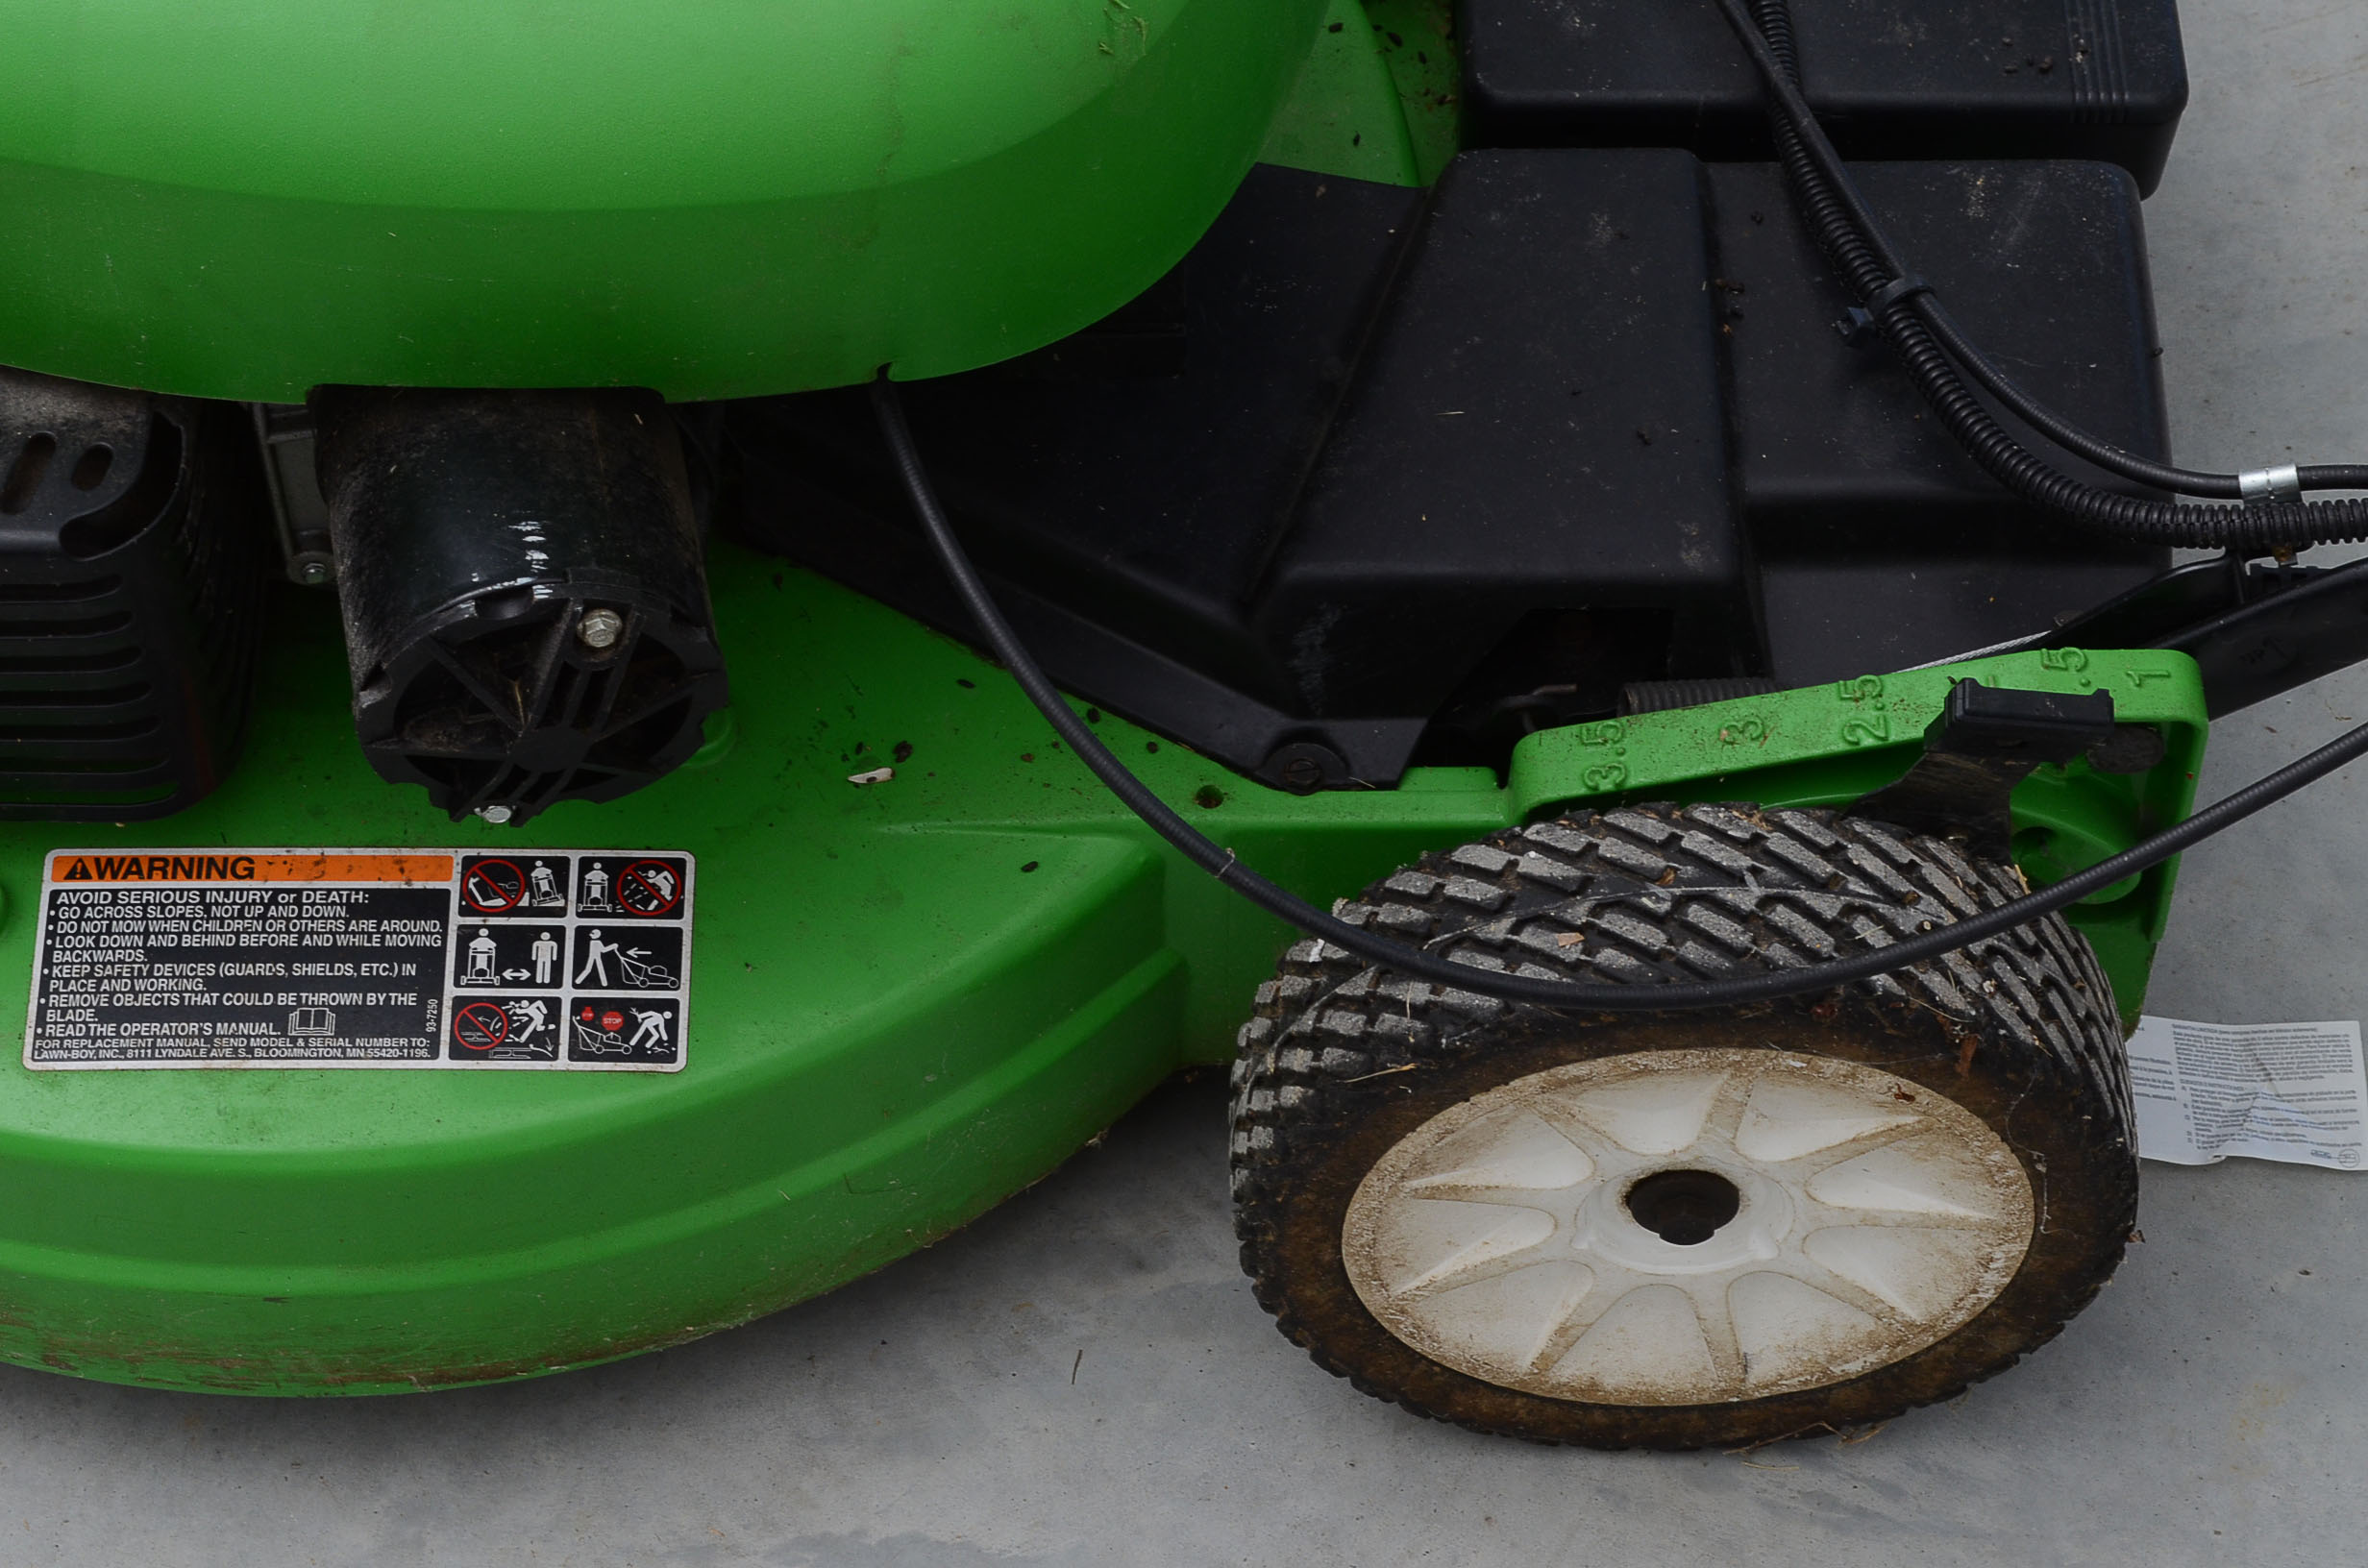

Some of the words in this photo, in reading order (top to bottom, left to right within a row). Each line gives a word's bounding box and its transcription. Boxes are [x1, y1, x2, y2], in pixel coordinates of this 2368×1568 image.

[2041, 646, 2088, 689] .5
[2125, 669, 2171, 687] 1
[93, 857, 256, 881] WARNING
[57, 892, 112, 904] AVOID
[117, 892, 201, 903] SERIOUS
[205, 891, 273, 903] INJURY
[278, 894, 297, 903] or
[302, 891, 369, 903] DEATH:
[58, 907, 81, 919] GO
[84, 906, 143, 918] ACROSS
[146, 906, 207, 919] SLOPES,
[210, 905, 240, 917] NOT
[267, 906, 299, 917] AND
[302, 906, 350, 917] DOWN.
[57, 921, 78, 933] DO
[80, 920, 110, 933] NOT
[111, 920, 146, 932] MOW
[148, 920, 189, 932] WHEN
[192, 919, 262, 931] CHILDREN
[265, 919, 286, 932] OR
[288, 919, 346, 931] OTHERS
[348, 920, 378, 931] ARE
[379, 920, 443, 932] AROUND.
[56, 936, 95, 947] LOOK
[98, 935, 143, 947] DOWN
[146, 935, 178, 946] AND
[181, 935, 235, 946] BEHIND
[239, 934, 299, 946] BEFORE
[302, 935, 333, 946] AND
[336, 935, 381, 946] WHILE
[385, 935, 442, 946] MOVING
[53, 949, 148, 962] BACKWARDS.
[52, 965, 90, 977] KEEP
[93, 965, 150, 976] SAFETY
[152, 964, 216, 976] DEVICES
[219, 964, 288, 979] (GUARDS,
[291, 964, 358, 977] SHIELDS,
[362, 963, 399, 977] ETC.)
[401, 964, 416, 975] IN
[49, 979, 97, 992] PLACE
[100, 979, 132, 992] AND
[134, 979, 207, 991] WORKING.
[48, 994, 111, 1007] REMOVE
[112, 993, 180, 1006] OBJECTS
[183, 993, 221, 1005] THAT
[223, 993, 274, 1005] COULD
[277, 993, 298, 1005] BE
[299, 992, 364, 1005] THROWN
[366, 993, 385, 1005] BY
[389, 993, 417, 1005] THE
[46, 1009, 98, 1021] BLADE.
[426, 998, 437, 1032] 93-7250
[45, 1024, 86, 1037] READ
[87, 1023, 116, 1036] THE
[216, 1023, 281, 1035] MANUAL.
[35, 1040, 62, 1048] FOR
[62, 1039, 154, 1048] REPLACEMENT
[156, 1039, 211, 1048] MANUAL,
[213, 1038, 247, 1046] SEND
[249, 1038, 295, 1046] MODEL
[308, 1038, 353, 1046] SERIAL
[355, 1038, 408, 1046] NUMBER
[411, 1038, 430, 1046] TO:
[34, 1049, 97, 1060] LAWN-BOY,
[126, 1049, 153, 1058] 8111
[155, 1048, 208, 1057] LYNDALE
[210, 1048, 236, 1057] AVE.
[254, 1048, 344, 1059] BLOOMINGTON,
[346, 1048, 364, 1057] MN
[366, 1048, 431, 1057] 55420-1196.
